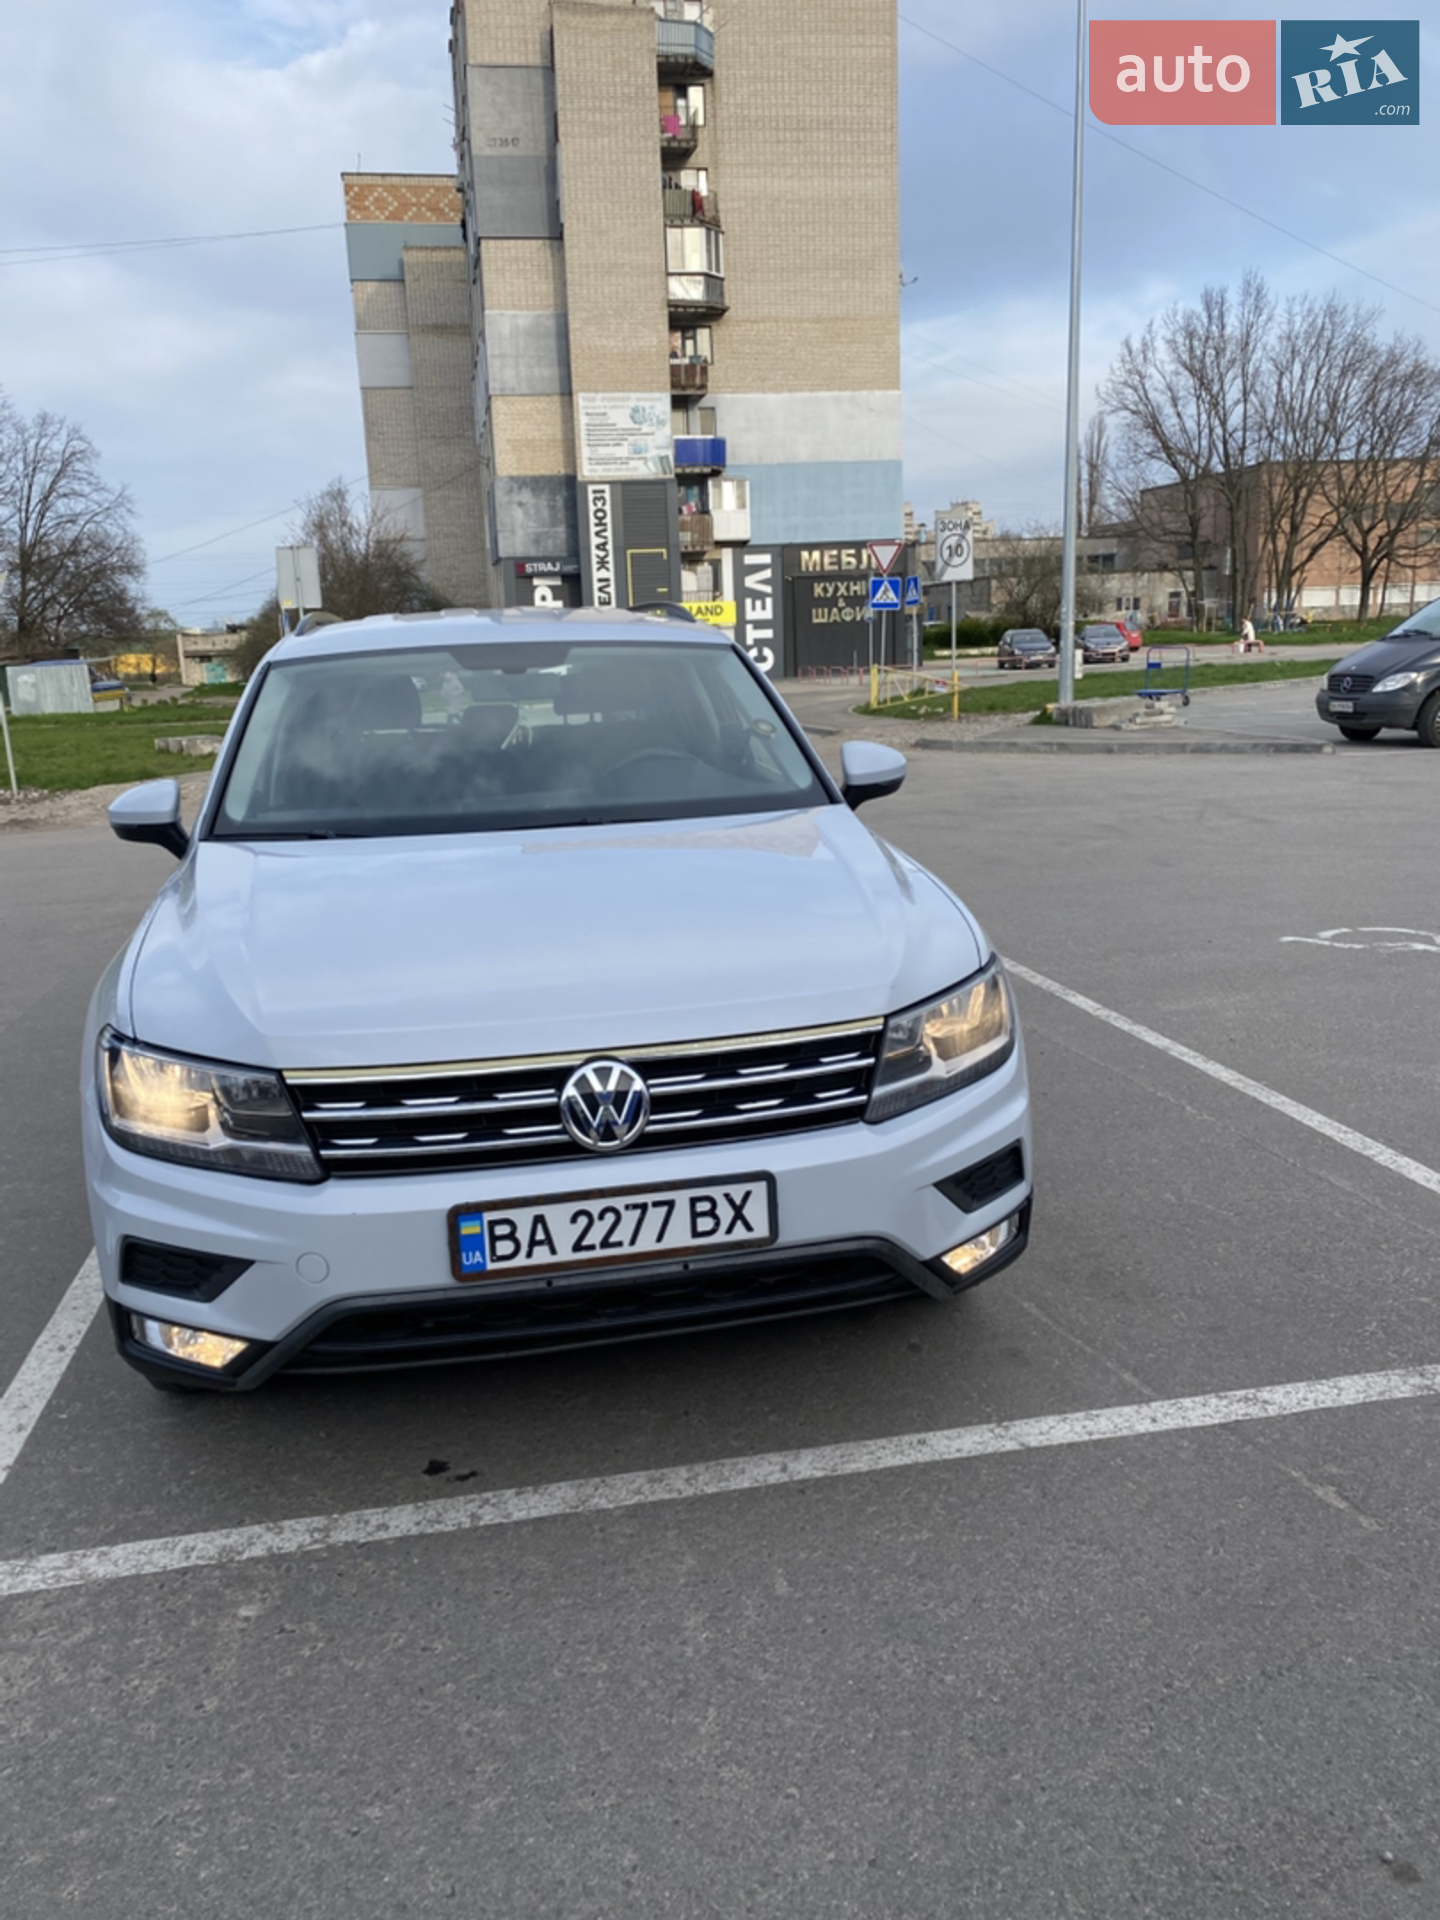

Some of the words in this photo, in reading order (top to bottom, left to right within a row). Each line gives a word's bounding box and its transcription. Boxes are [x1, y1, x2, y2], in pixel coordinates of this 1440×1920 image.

[592, 489, 610, 573] ЖАЛЮЗІ
[940, 520, 971, 533] ЗОНА
[946, 543, 964, 558] 10
[800, 548, 878, 572] МЕБЛ
[597, 577, 612, 606] ЕЛІ
[813, 581, 867, 598] КУХНІ
[688, 604, 724, 616] LAND
[743, 553, 775, 673] СТЕЛІ
[811, 606, 870, 623] ШАФИ
[487, 1213, 558, 1263] BA
[569, 1199, 676, 1253] 2277
[689, 1190, 755, 1239] BX
[461, 1251, 484, 1266] UA
